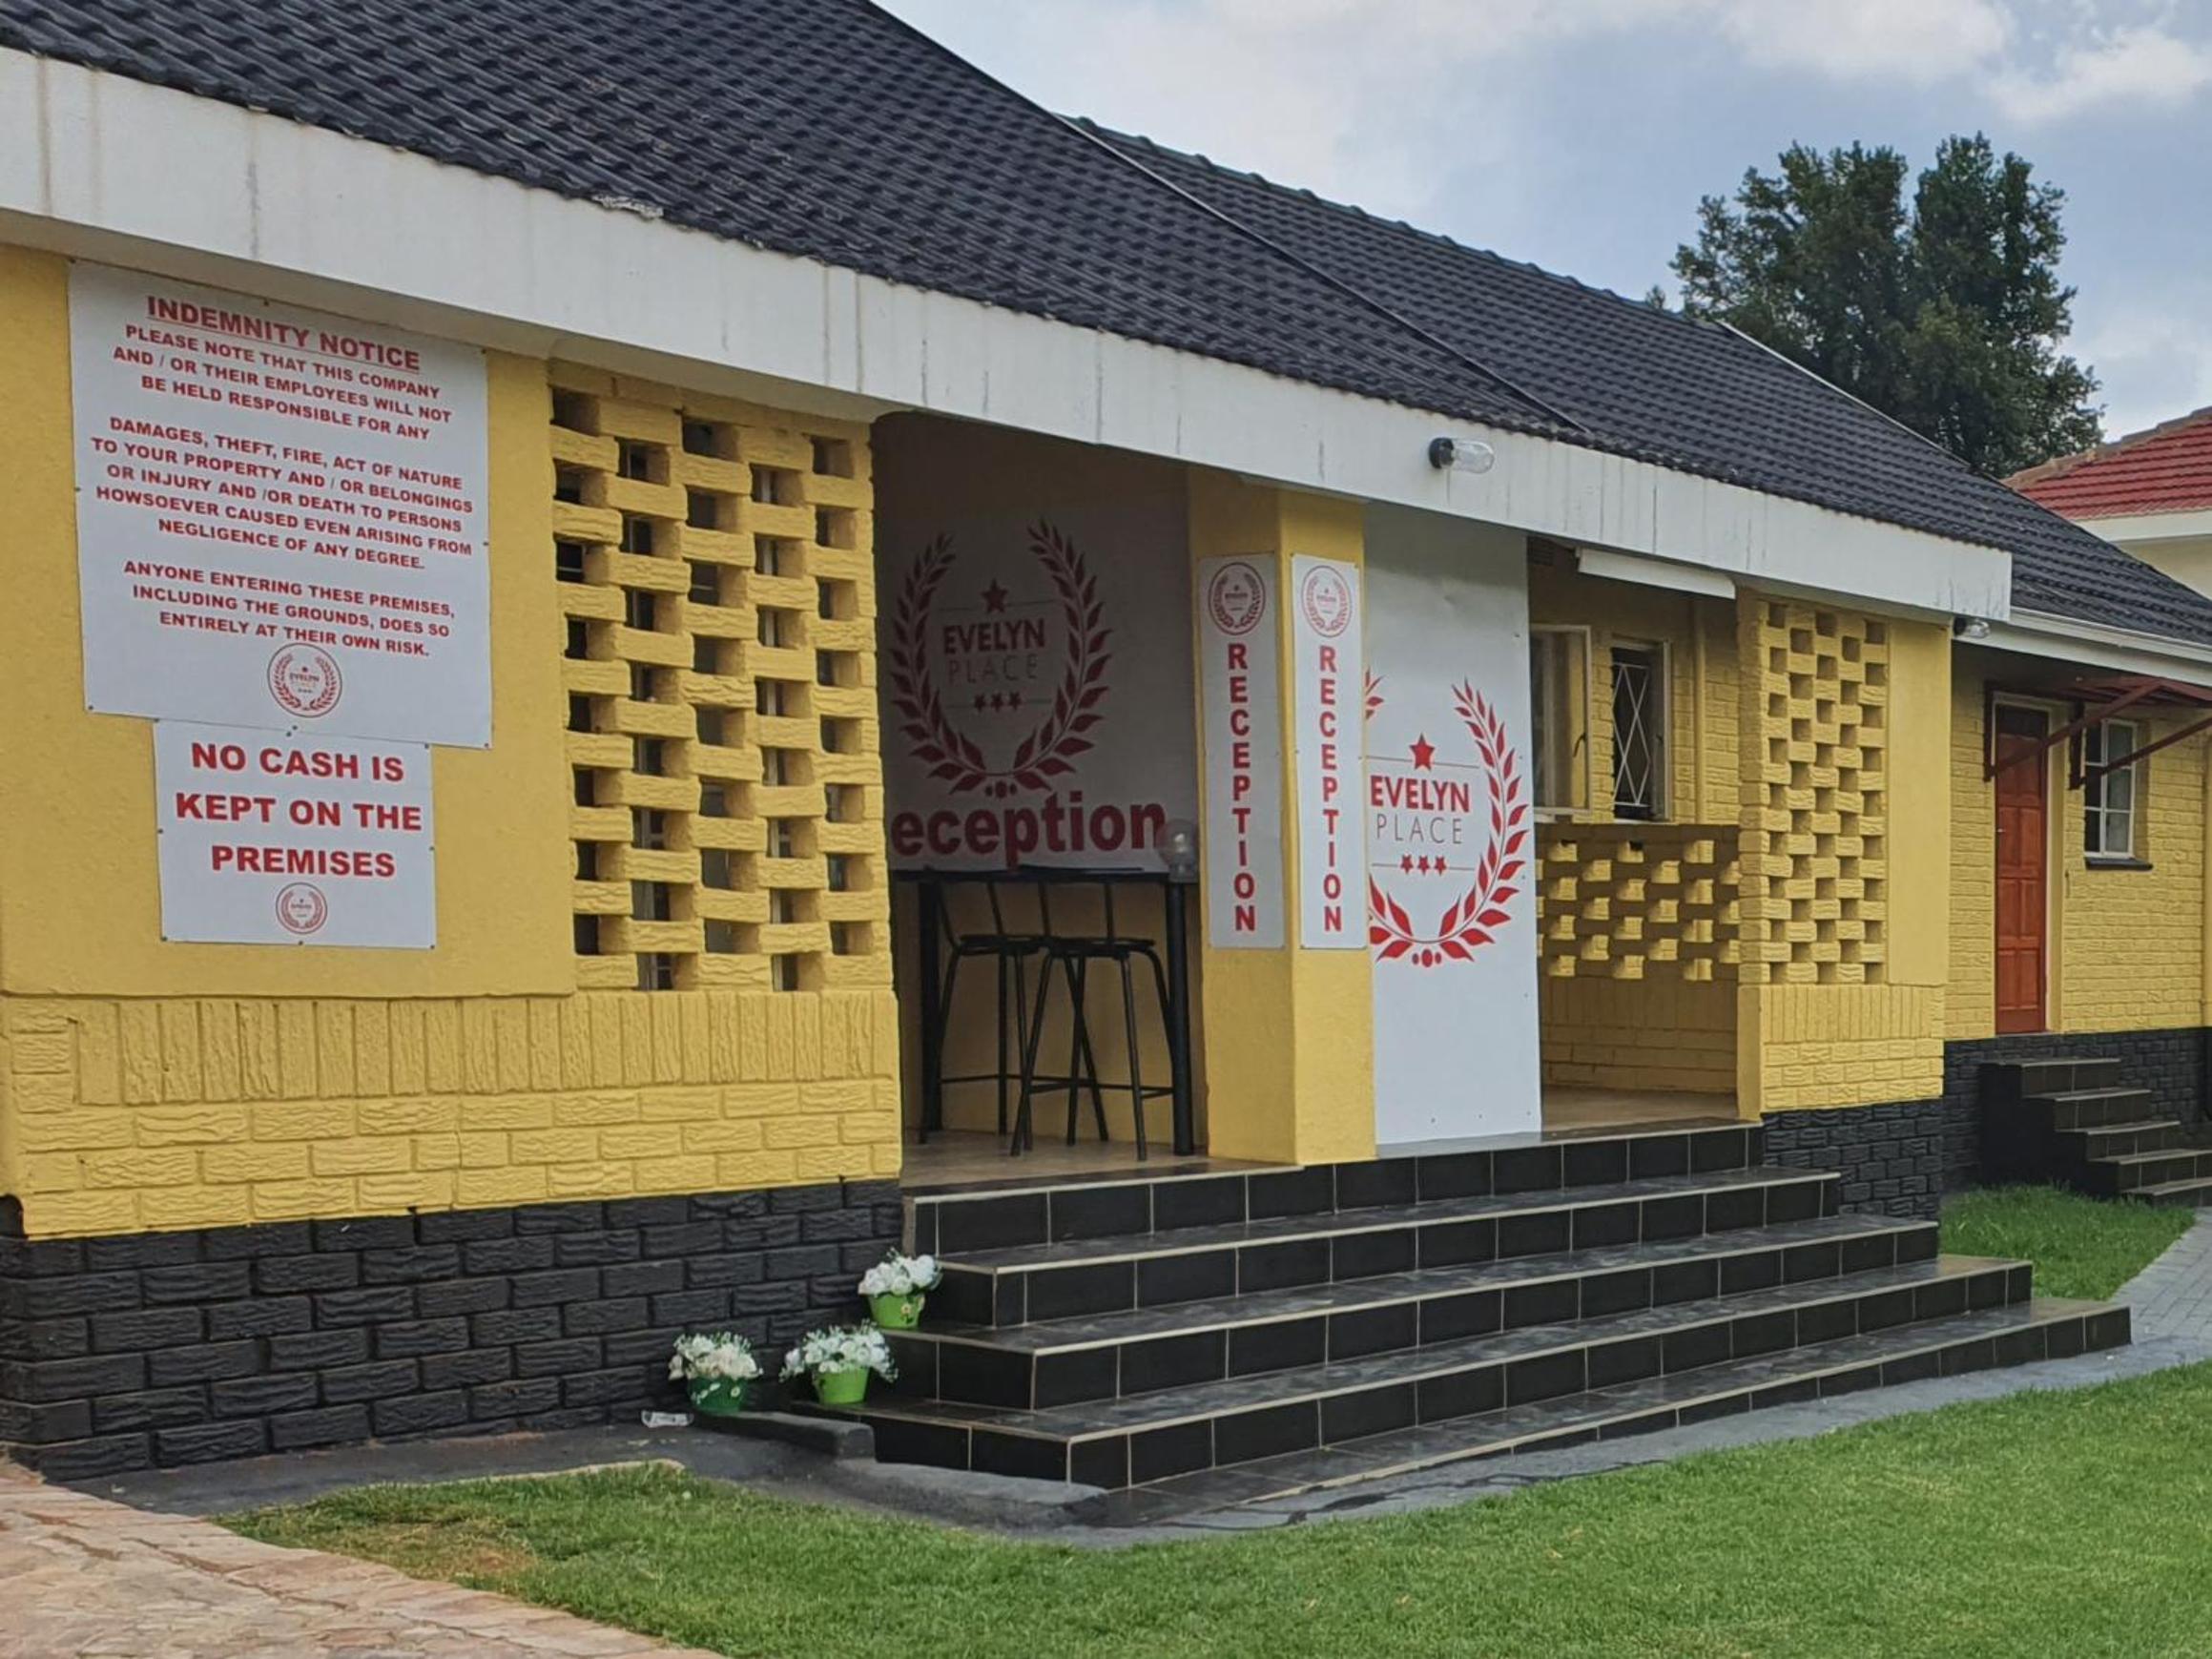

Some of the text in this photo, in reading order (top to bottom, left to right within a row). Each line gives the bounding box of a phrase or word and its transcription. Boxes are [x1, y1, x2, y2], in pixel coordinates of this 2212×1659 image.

[126, 325, 440, 399] PLEASE NOTE THAT THIS COMPANY
[147, 296, 420, 370] INDEMNITY NOTICE
[114, 346, 153, 365] AND
[171, 358, 196, 375] OR
[202, 363, 258, 385] THEIR
[265, 376, 368, 407] EMPLOYEES
[374, 397, 412, 416] WILL
[419, 406, 452, 423] NOT
[142, 376, 429, 440] BE HELD RESPONSIBLE FOR ANY
[92, 437, 117, 454] TO
[124, 443, 177, 465] YOUR
[184, 452, 281, 481] PROPERTY
[288, 470, 324, 487] AND
[341, 479, 363, 493] OR
[369, 485, 473, 513] BELONGINGS
[110, 417, 463, 489] DAMAGES, THEFT, FIRE, ACT OF NATURE
[96, 487, 472, 555] HOWSOEVER CAUSED EVEN ARISING FROM
[107, 465, 133, 480] OR
[142, 470, 210, 492] INJURY
[218, 484, 257, 500] AND
[299, 494, 355, 515] DEATH
[361, 505, 382, 519] TO
[388, 509, 462, 532] PERSONS
[158, 519, 425, 570] NEGLIGENCE OF ANY DEGREE.
[124, 561, 455, 618] ANYONE ENTERING THESE PREMISES,
[133, 585, 449, 636] INCLUDING THE GROUNDS, DOES SO
[160, 612, 429, 656] ENTIRELY AT THEIR OWN RISK.
[943, 619, 1044, 654] EVELYN
[950, 654, 1038, 684] PLACE
[192, 743, 403, 781] NO CASH IS
[1228, 643, 1255, 932] RECEPTION
[1319, 645, 1341, 932] RECEPTION
[176, 793, 422, 830] KEPT ON THE
[1371, 775, 1469, 812] EVELYN
[891, 791, 1165, 872] eception
[1377, 814, 1462, 844] PLACE
[212, 845, 395, 877] PREMISES
